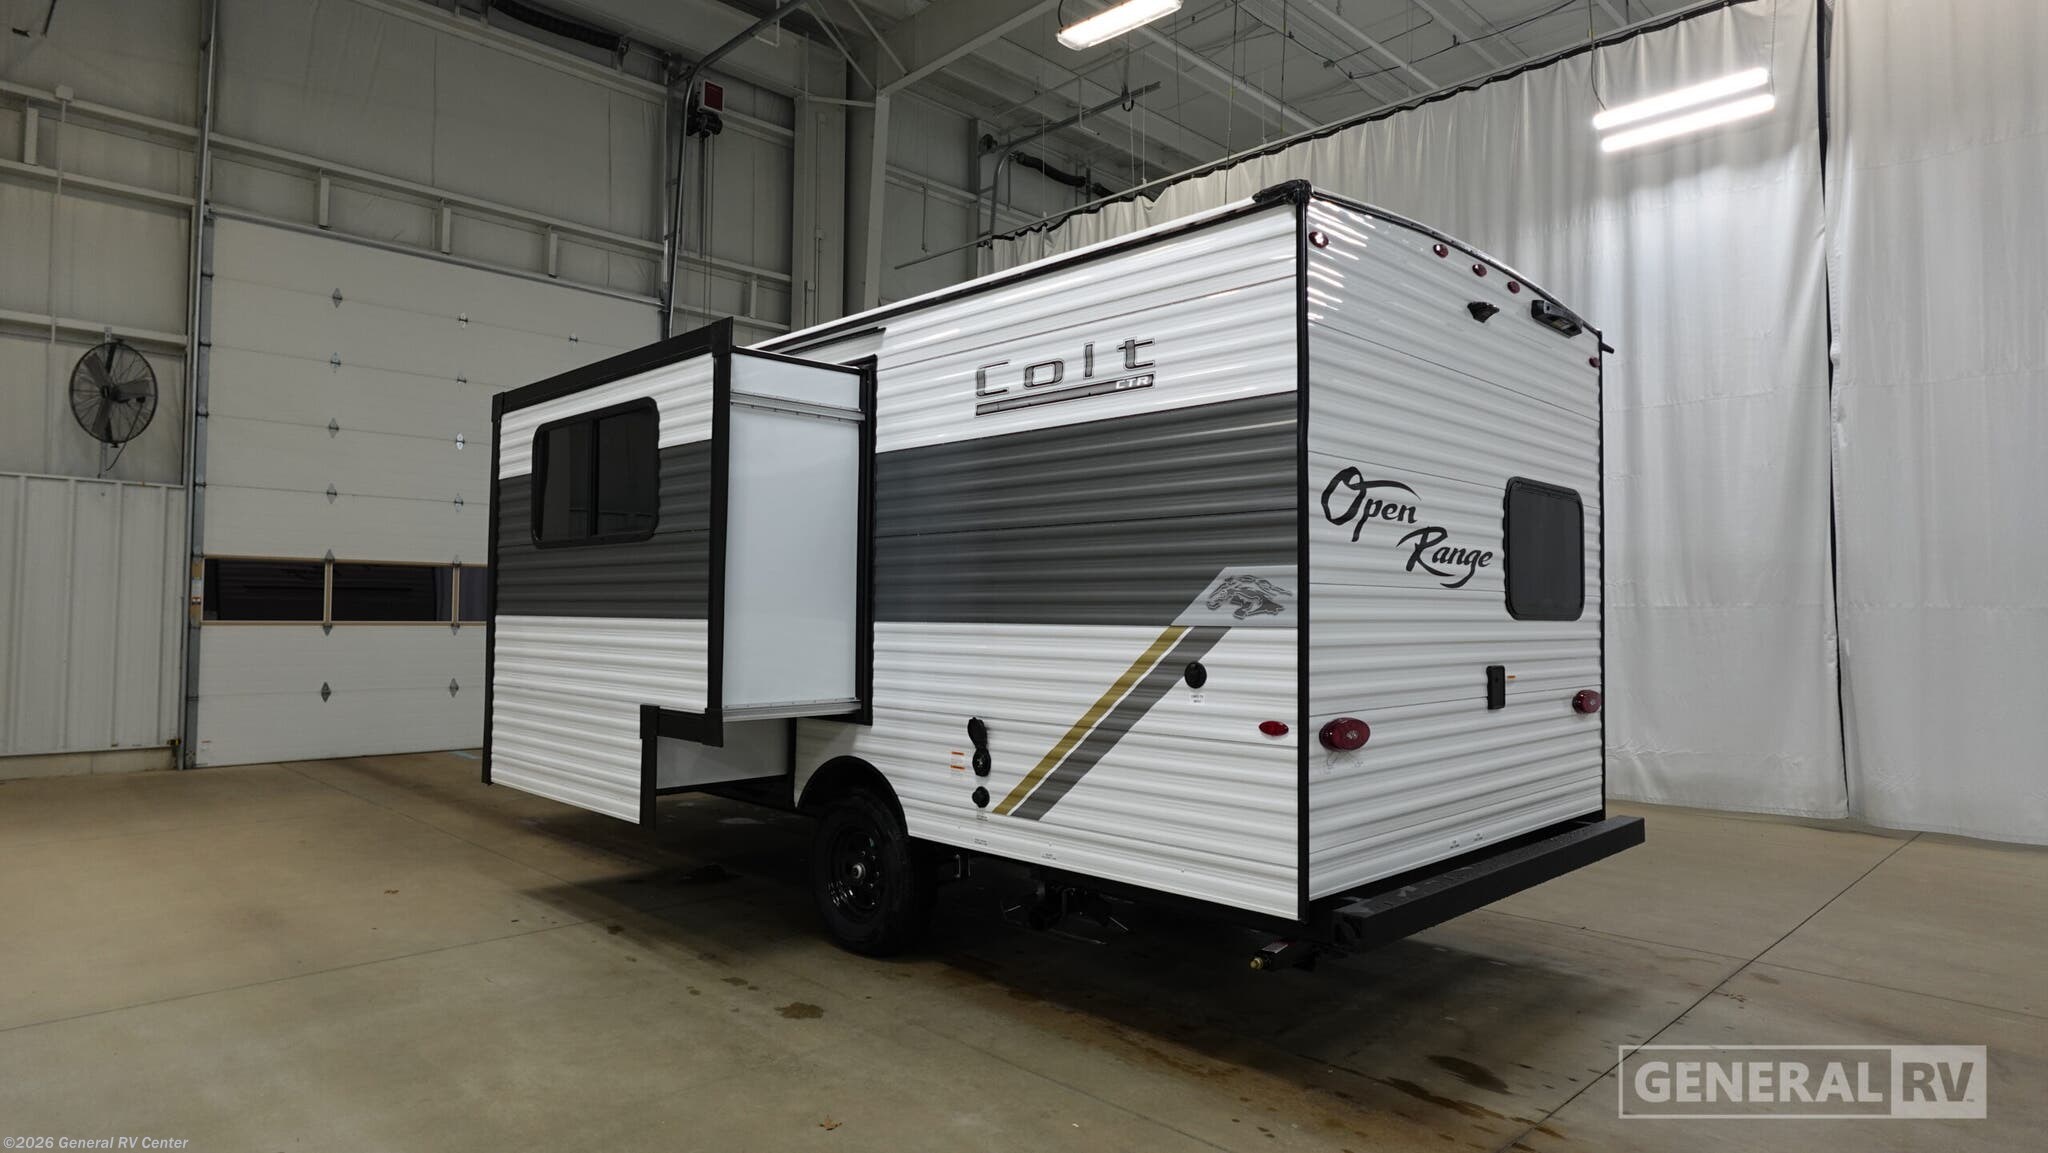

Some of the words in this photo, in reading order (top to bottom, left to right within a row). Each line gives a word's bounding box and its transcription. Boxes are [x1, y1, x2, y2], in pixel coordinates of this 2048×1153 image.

[975, 338, 1155, 397] Colt
[1115, 376, 1149, 390] CTR
[1321, 466, 1422, 542] Open
[1396, 526, 1493, 589] Range
